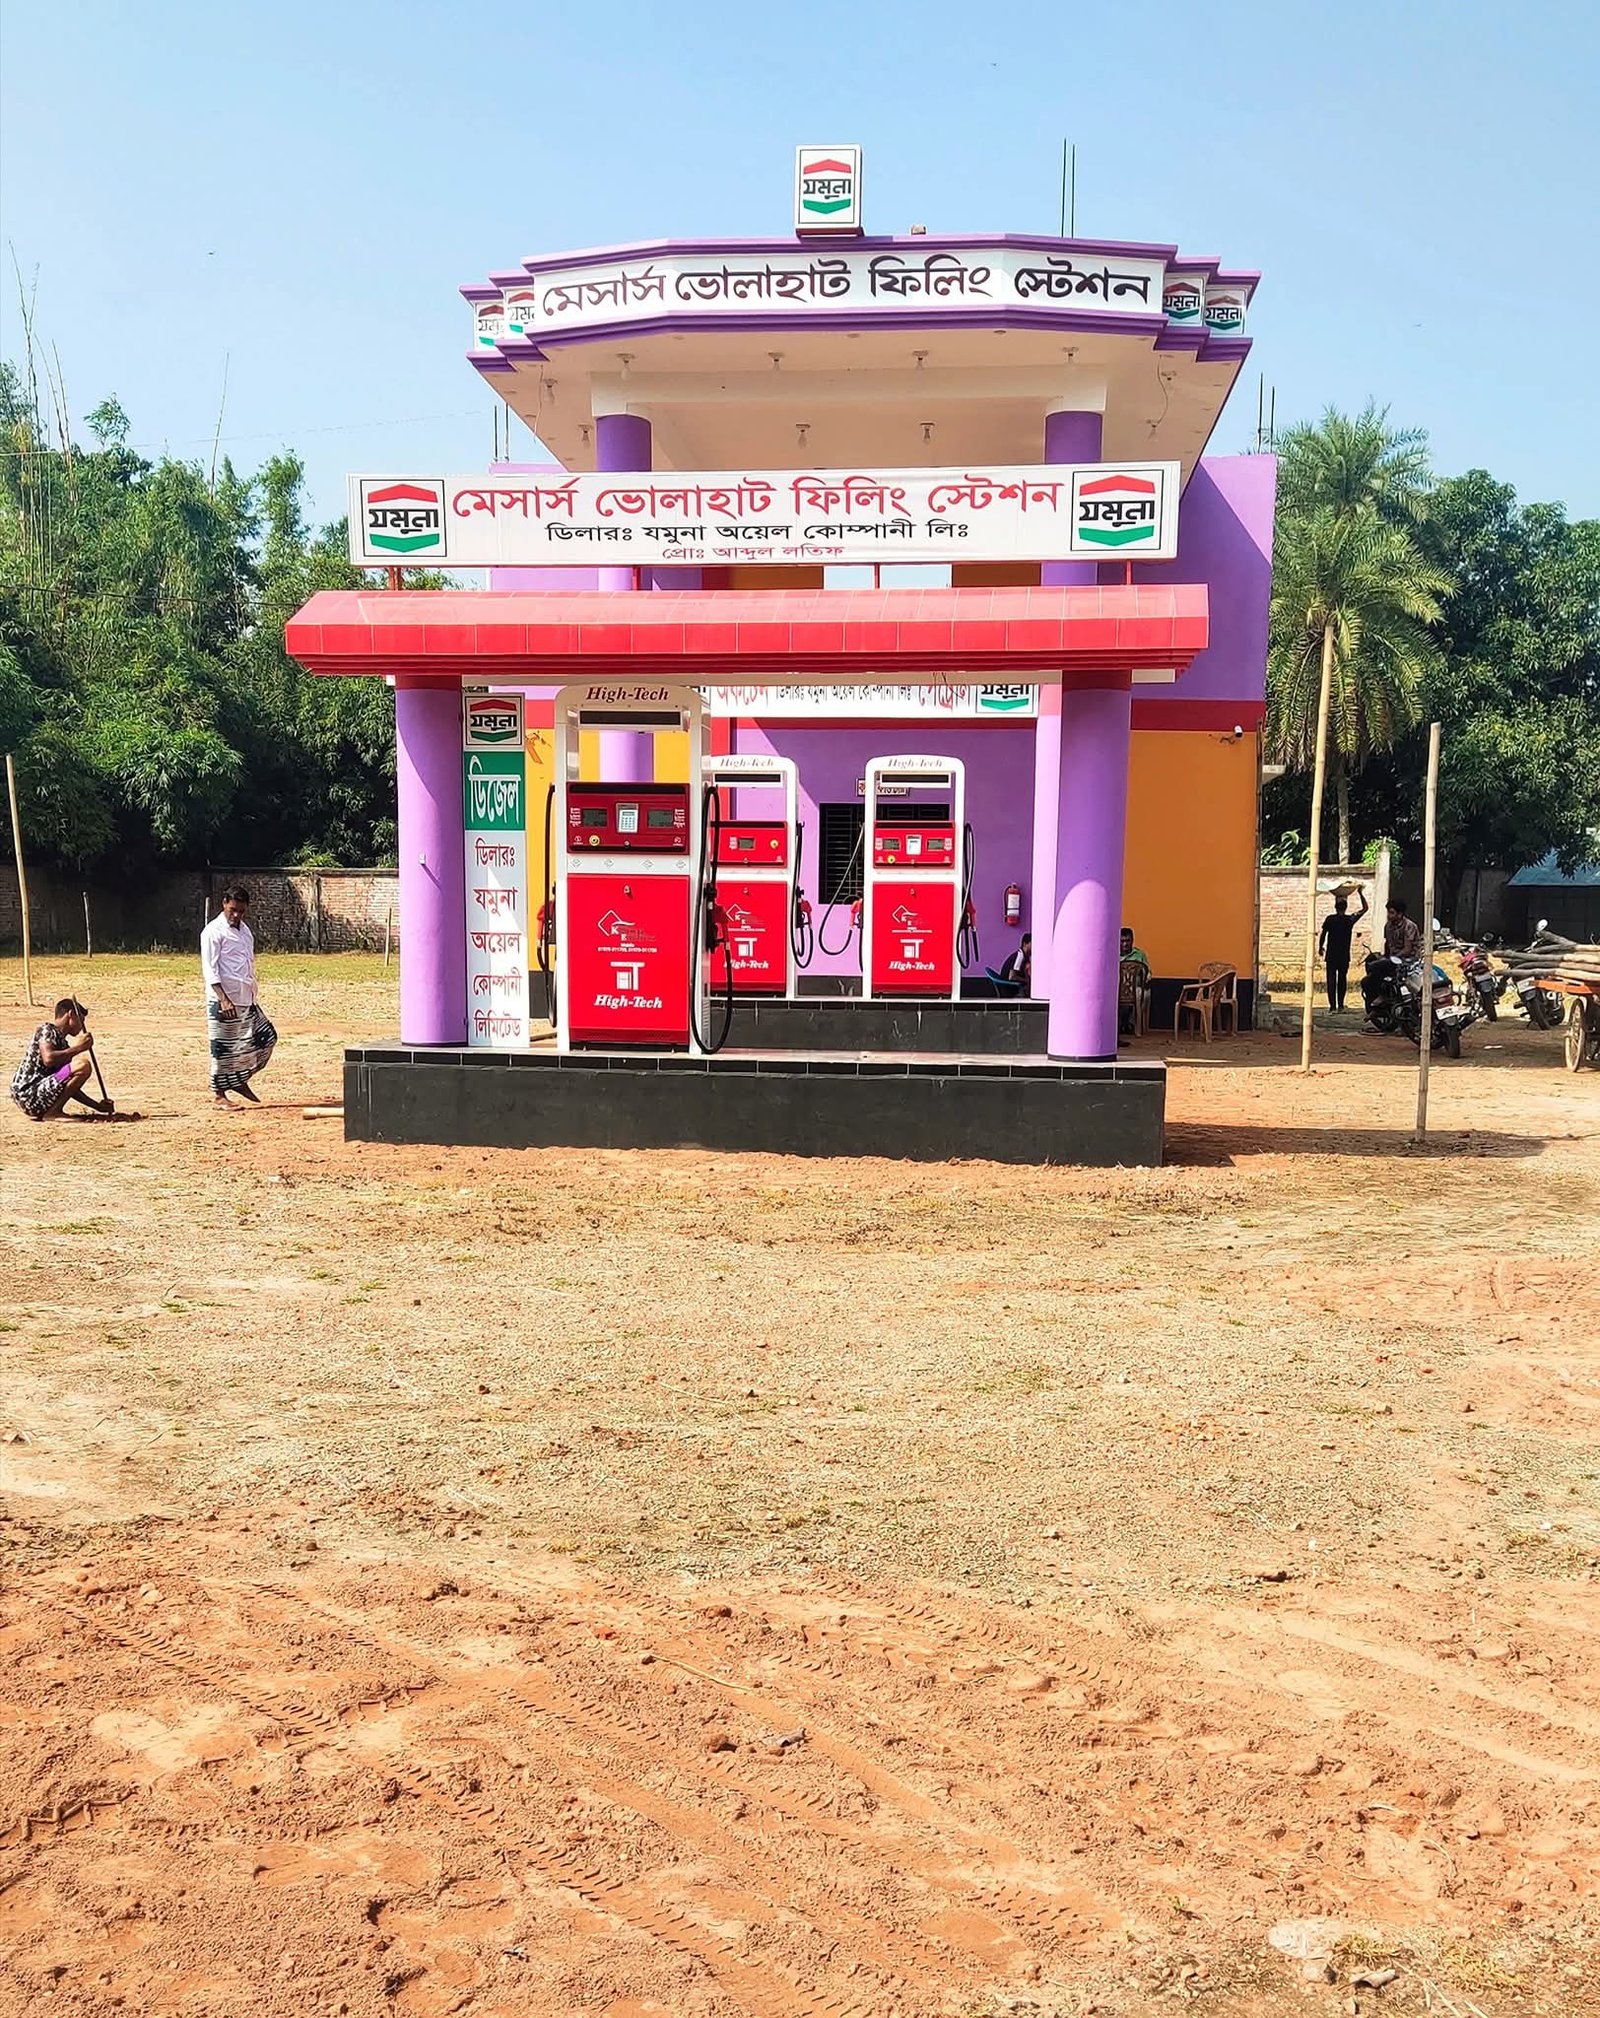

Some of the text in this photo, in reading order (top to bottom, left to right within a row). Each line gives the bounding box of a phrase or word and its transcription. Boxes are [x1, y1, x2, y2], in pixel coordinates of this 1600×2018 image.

[802, 178, 852, 200] যমুনা
[543, 253, 1151, 316] মেসার্স ভোলাহাট ফিলিং স্টেশন
[452, 473, 1064, 520] মেসার্স ভোলাহাট ফিলিং স্টেশন
[368, 508, 440, 535] যমুনা
[1078, 500, 1156, 528] যমুনা
[545, 518, 969, 545] ডিলারঃ যমুনা অয়েল কোম্পানী লিঃ
[661, 546, 705, 561] প্রোঃ
[782, 542, 846, 559] লতিফ
[586, 686, 670, 703] High-Tech
[469, 714, 518, 732] যমুনা
[720, 757, 775, 769] High-Tech
[887, 757, 944, 769] High-Tech
[467, 754, 522, 825] ডিজেল
[475, 837, 516, 868] ডিলারঃ
[473, 886, 519, 918] যমুনা
[470, 931, 523, 955] অয়েল
[887, 960, 936, 971] High-Tech
[473, 966, 523, 997] কোম্পানী
[593, 993, 663, 1010] High-Tech
[474, 1009, 523, 1039] লিমিটেড
